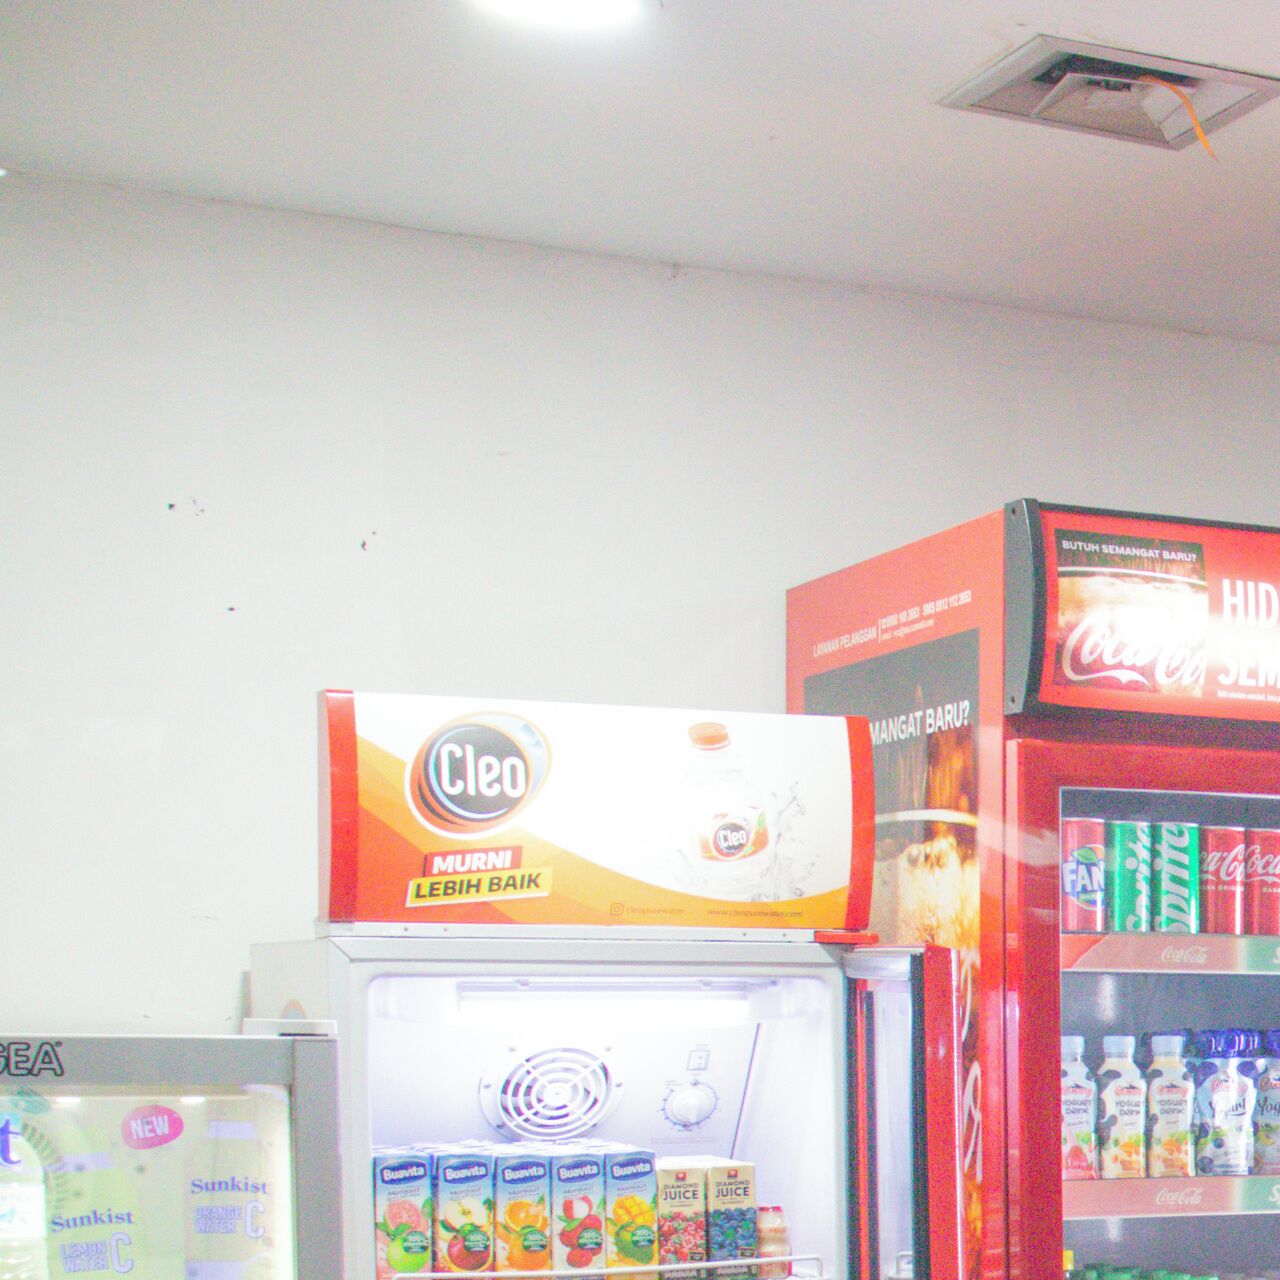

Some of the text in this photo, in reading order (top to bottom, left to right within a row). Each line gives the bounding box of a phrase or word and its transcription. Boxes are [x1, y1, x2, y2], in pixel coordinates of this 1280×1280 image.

[1061, 539, 1197, 563] BUTUH SEMANGAT BARU?
[926, 700, 970, 734] BARU?
[439, 742, 527, 799] Cleo
[432, 849, 512, 876] MURNI
[414, 872, 541, 899] LEBIH BAIK
[129, 1114, 170, 1140] NEW
[383, 1162, 428, 1182] Buavita
[444, 1163, 489, 1182] Buavita
[502, 1163, 545, 1181] Buavita
[190, 1176, 270, 1195] Sunkist
[663, 1189, 699, 1201] JUICE
[714, 1180, 750, 1190] DIAMOND
[714, 1185, 751, 1199] JUICE
[51, 1208, 134, 1233] Sunkist
[194, 1200, 266, 1239] ORANGE C
[59, 1232, 134, 1274] LEMON C
[62, 1255, 108, 1274] WATER
